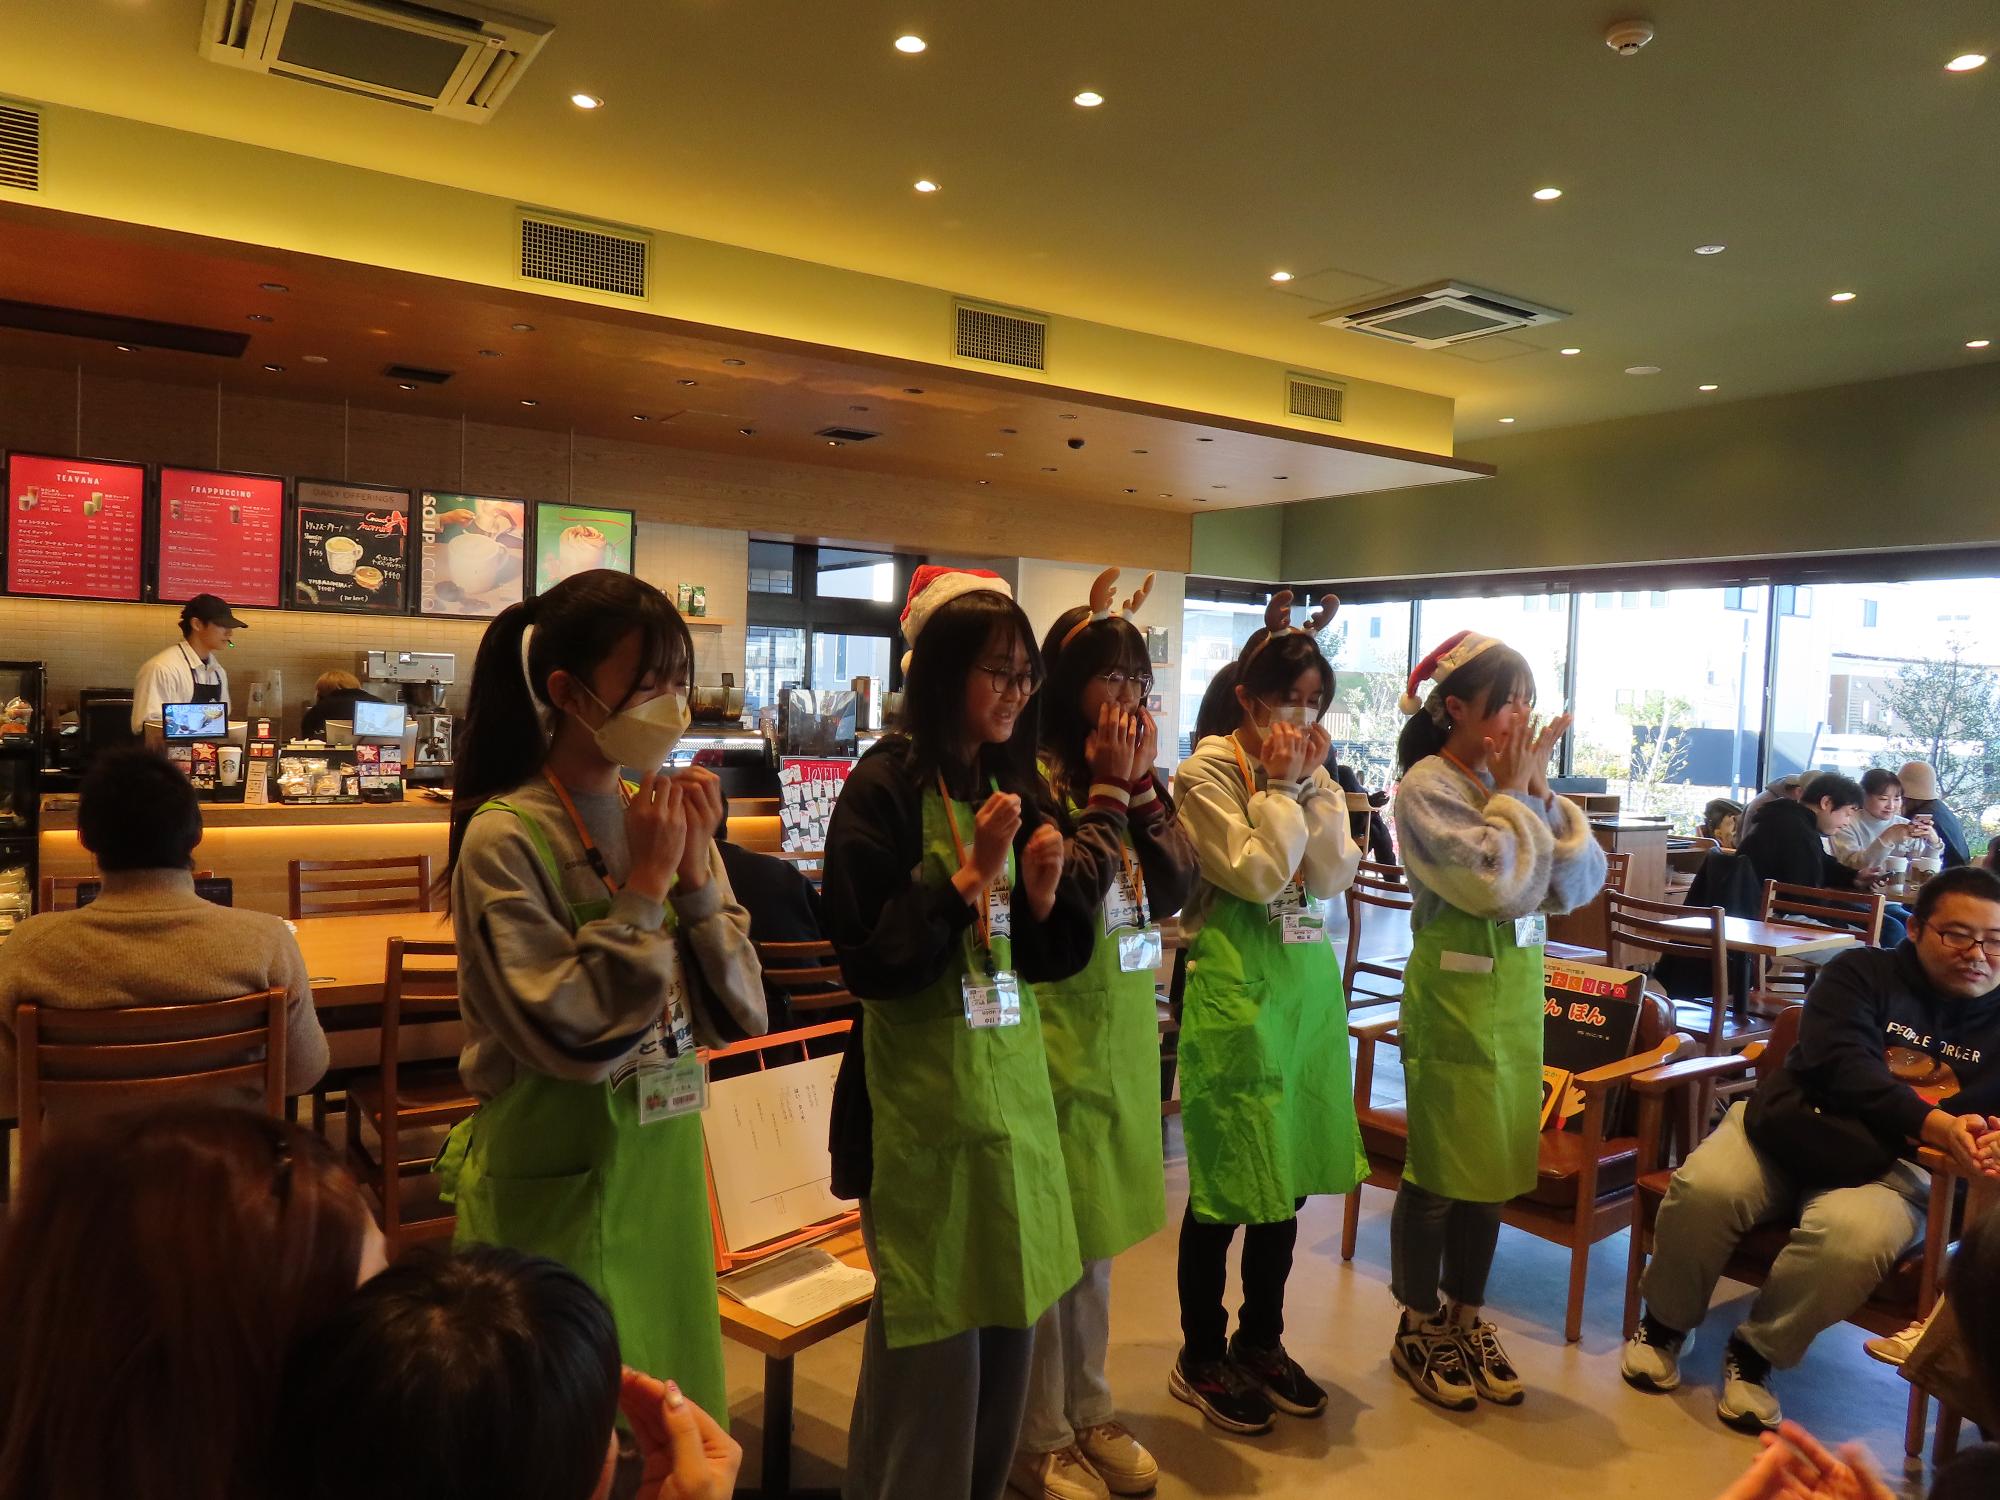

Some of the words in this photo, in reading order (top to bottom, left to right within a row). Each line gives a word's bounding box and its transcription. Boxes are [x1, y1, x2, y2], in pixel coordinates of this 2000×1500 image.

[56, 473, 100, 485] TEAVANA
[191, 485, 252, 498] FRAPPUCCINO
[342, 490, 395, 503] OFFERINGS
[1886, 1021, 1932, 1048] PEOPLE
